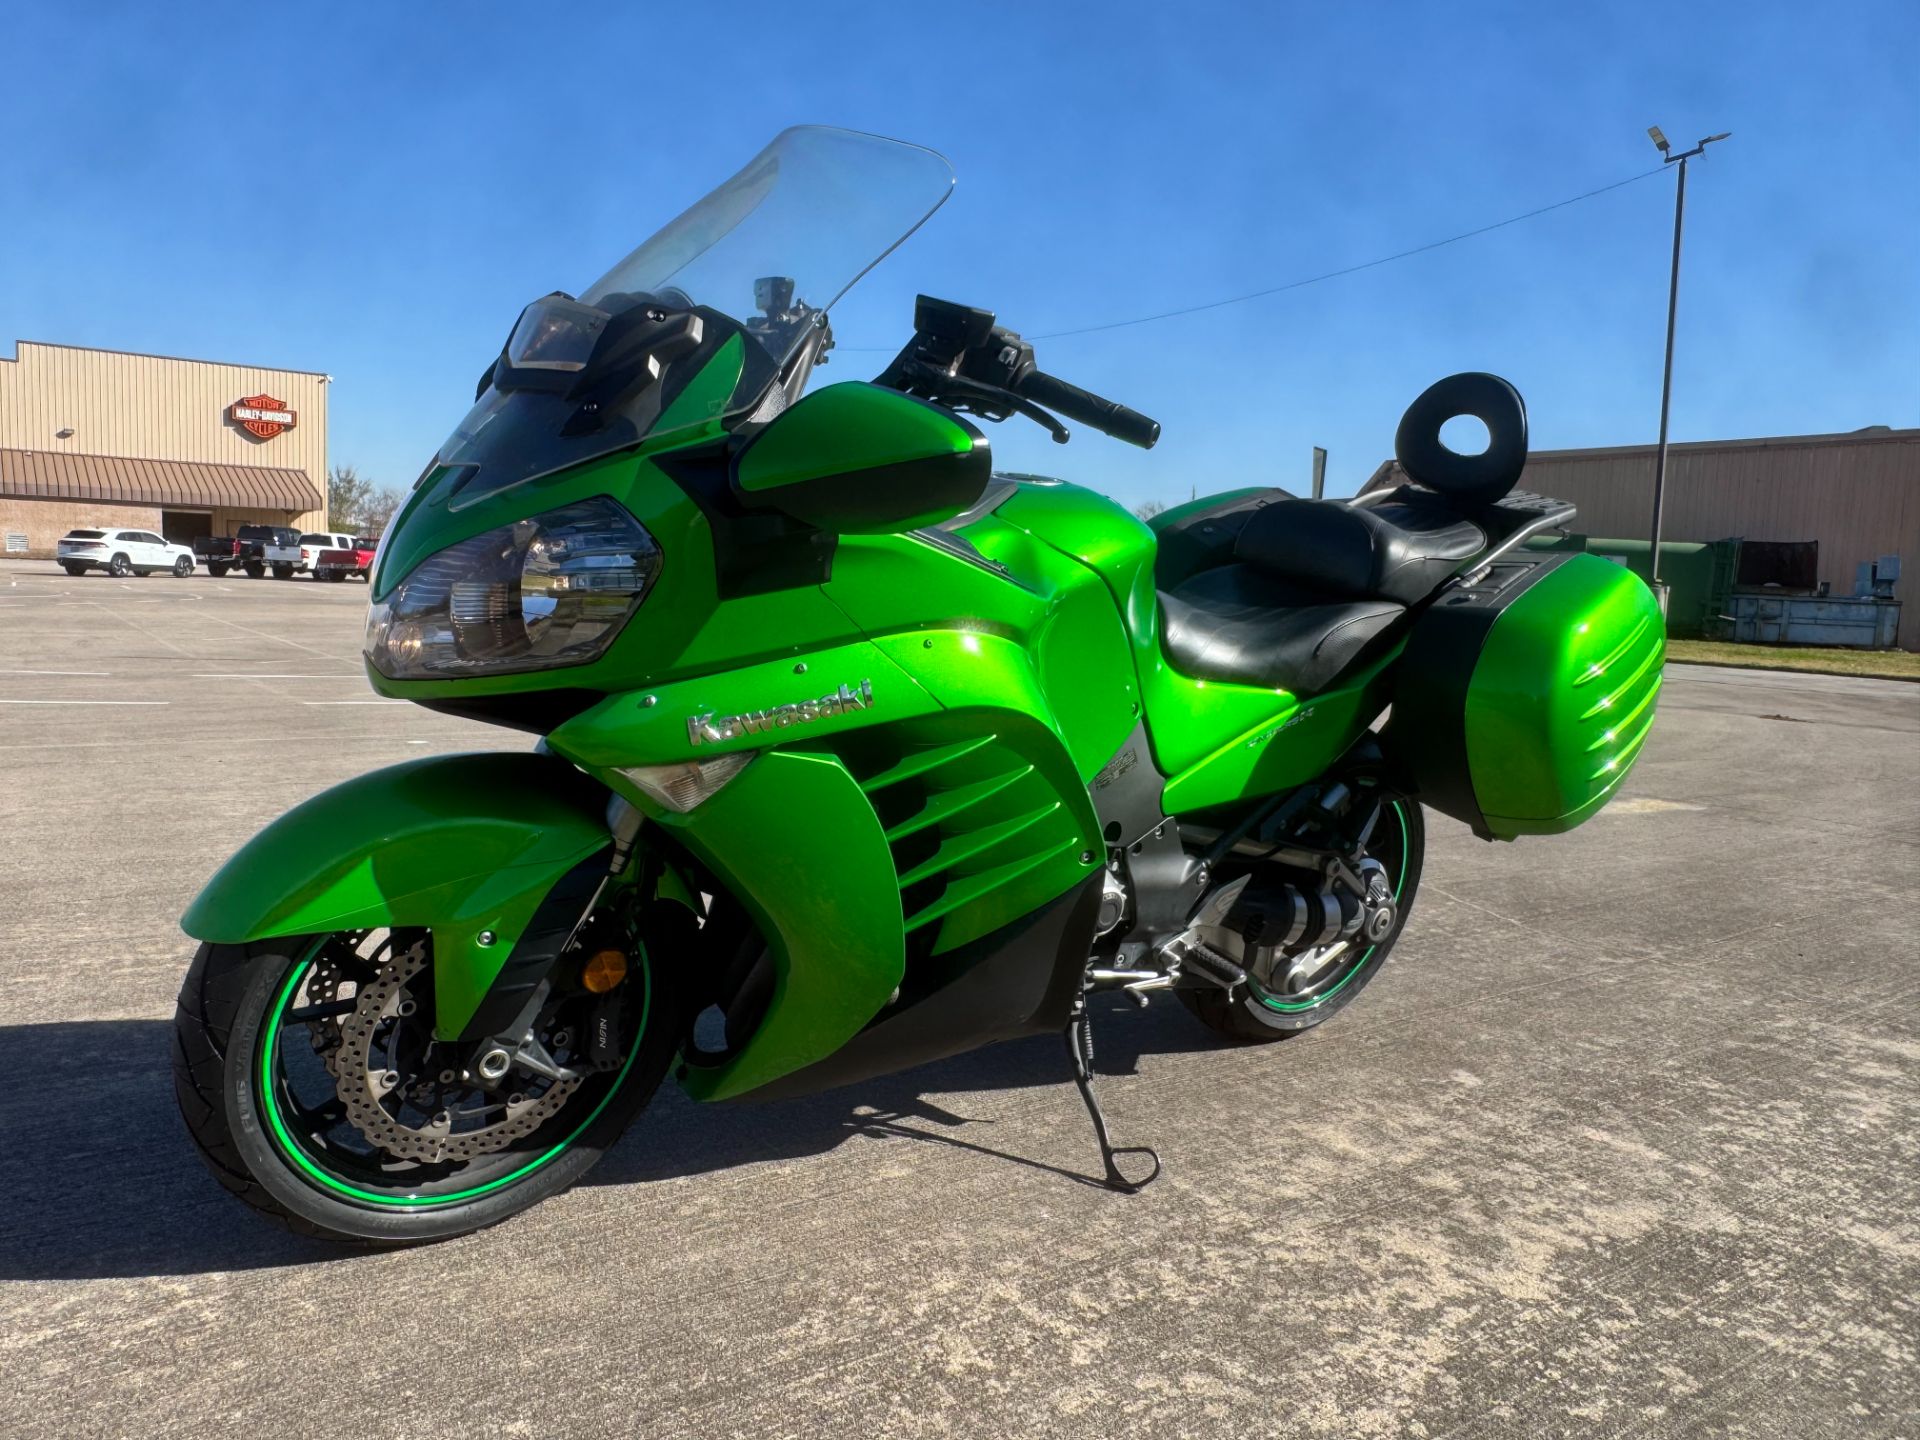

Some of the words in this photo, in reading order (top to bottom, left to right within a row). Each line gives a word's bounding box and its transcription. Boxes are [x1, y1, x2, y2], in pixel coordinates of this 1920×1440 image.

[249, 398, 279, 410] MOTOR
[248, 421, 279, 435] CYCLES
[686, 678, 874, 747] Kawasaki
